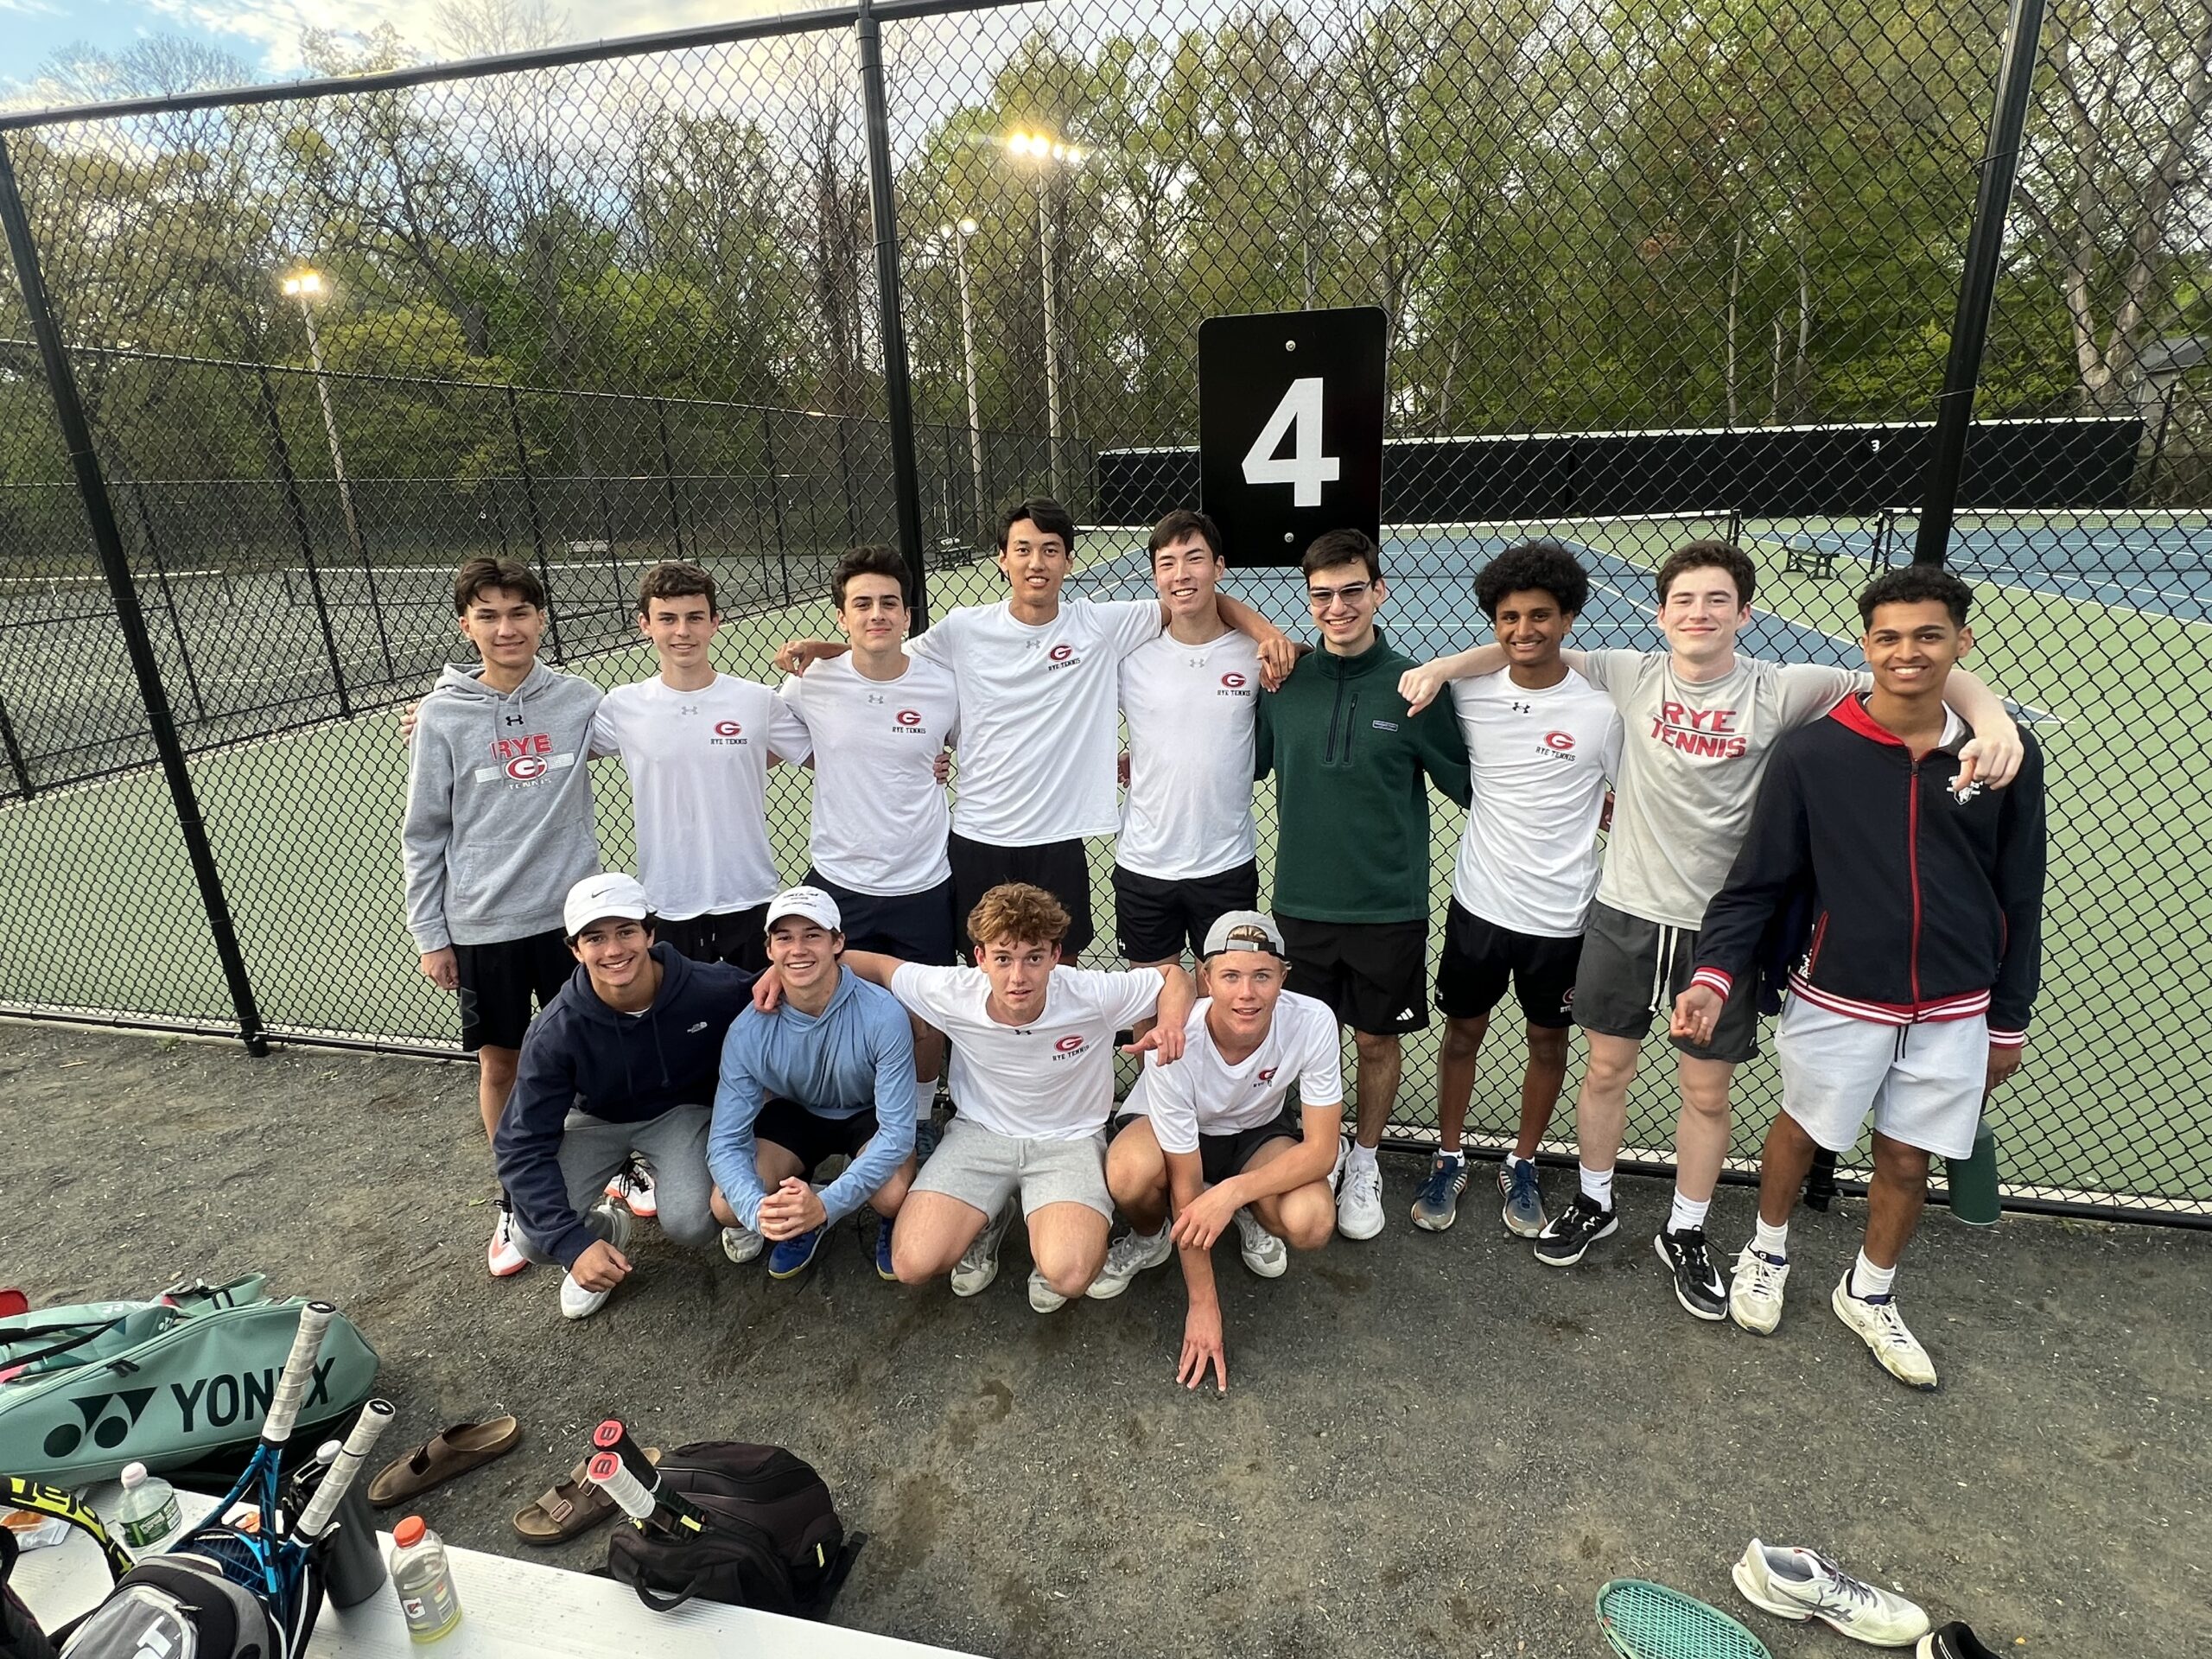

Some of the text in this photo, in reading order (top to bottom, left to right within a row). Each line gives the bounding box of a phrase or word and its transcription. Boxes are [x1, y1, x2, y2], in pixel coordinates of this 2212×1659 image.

[1242, 378, 1340, 506] 4
[1871, 439, 1880, 452] 3
[1663, 701, 1736, 733] RYE
[489, 733, 553, 761] RYE
[1651, 716, 1746, 759] TENNIS
[509, 778, 552, 790] TENNIS
[170, 1357, 336, 1433] YONX
